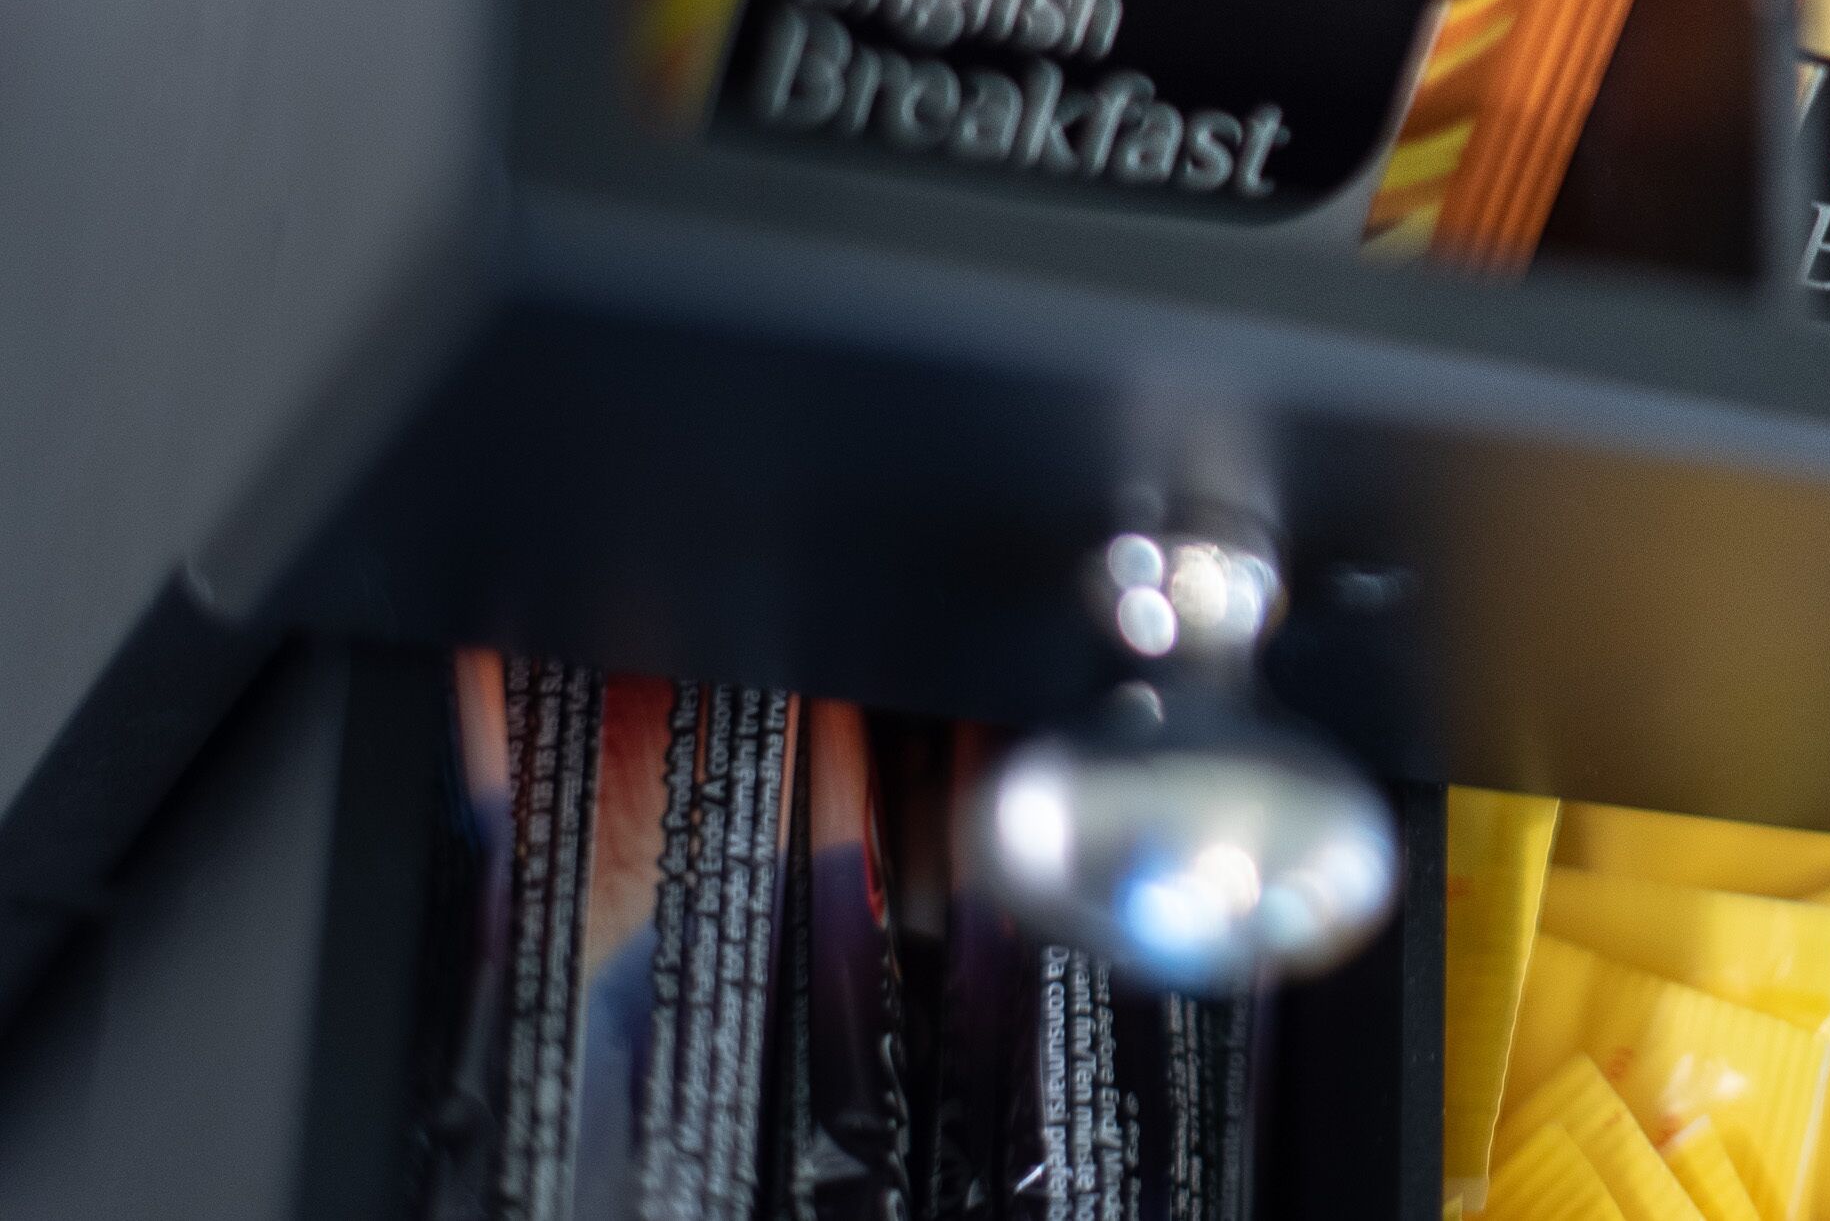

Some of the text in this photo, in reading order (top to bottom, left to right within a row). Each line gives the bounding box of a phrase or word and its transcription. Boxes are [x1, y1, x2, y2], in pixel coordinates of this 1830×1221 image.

[757, 2, 1292, 196] Breakfast
[667, 734, 695, 828] Produits
[702, 778, 727, 799] A
[662, 834, 689, 875] des
[697, 800, 727, 873] Ende/
[1042, 946, 1070, 978] Da
[1046, 982, 1072, 1123] consumarsi
[1097, 1004, 1116, 1085] Before
[1074, 1105, 1096, 1192] minste
